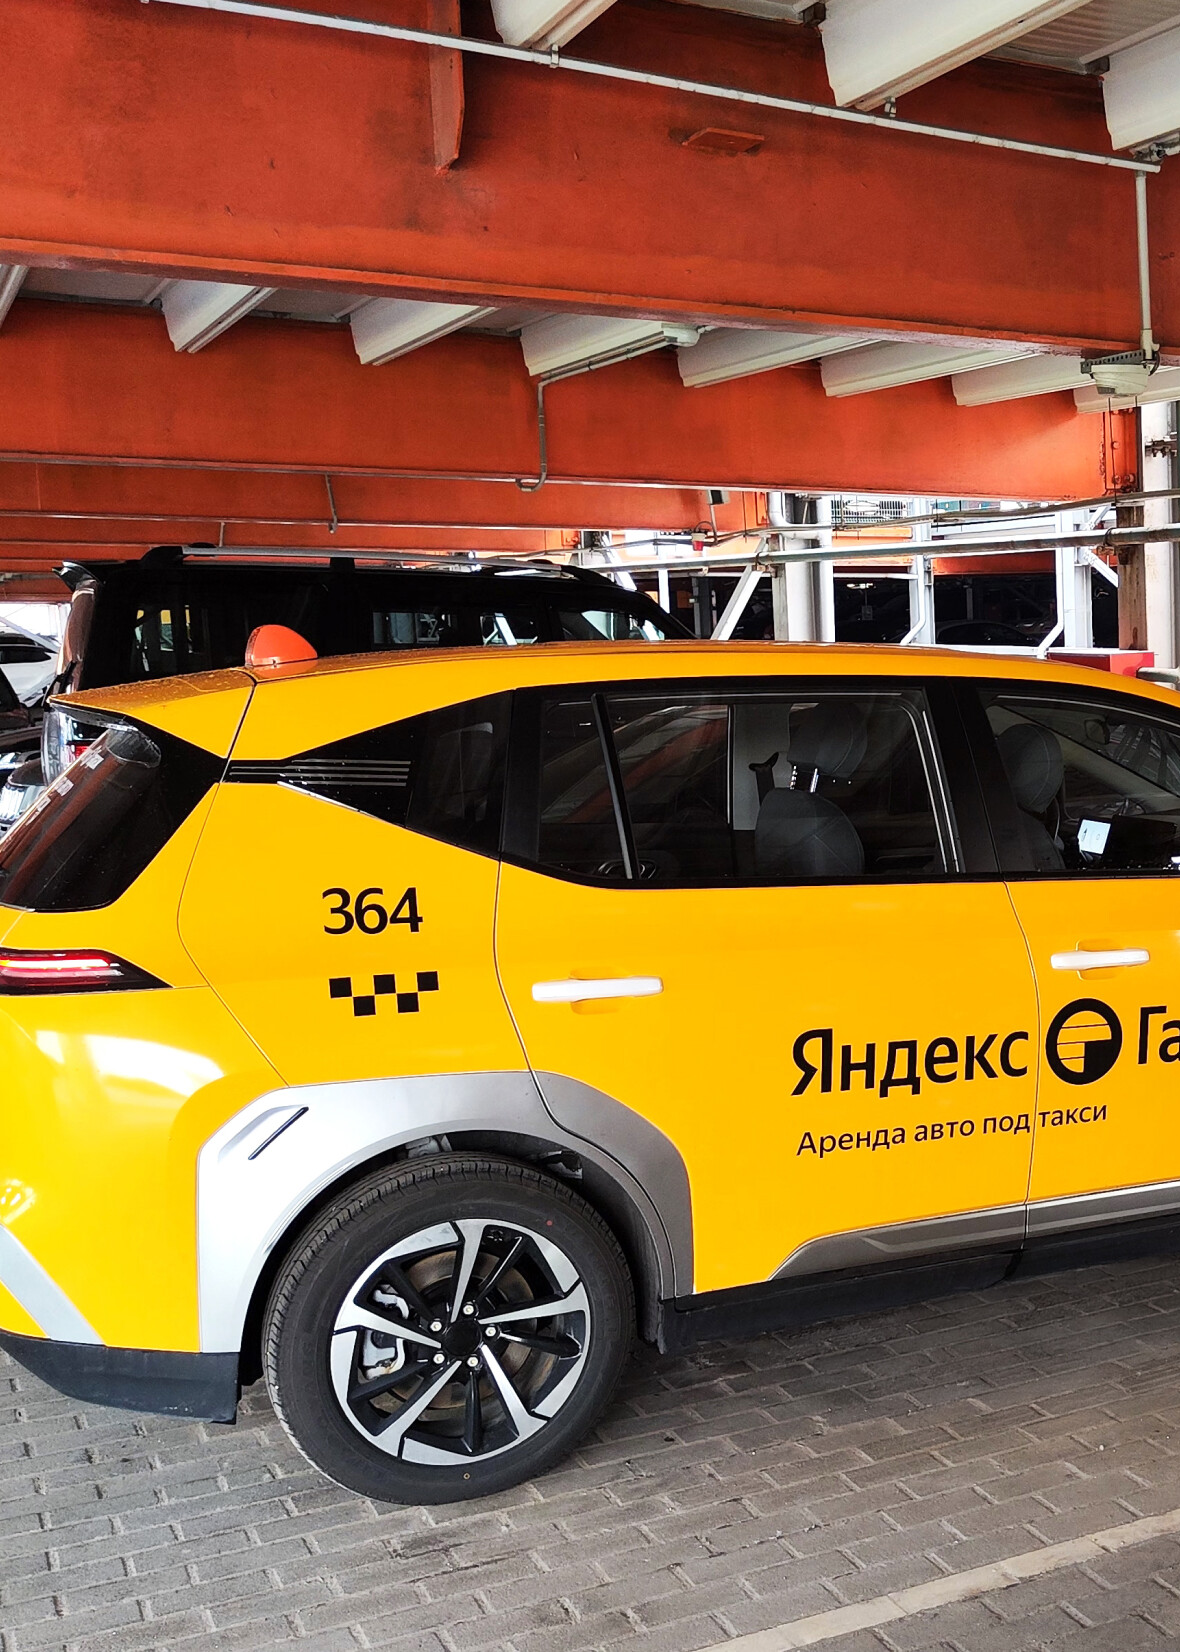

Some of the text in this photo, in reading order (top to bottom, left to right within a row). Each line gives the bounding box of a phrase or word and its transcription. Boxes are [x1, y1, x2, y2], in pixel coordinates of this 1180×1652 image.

[322, 887, 423, 935] 364
[791, 1028, 1029, 1098] Яндекс
[797, 1105, 1107, 1159] Аренда авто под такси
